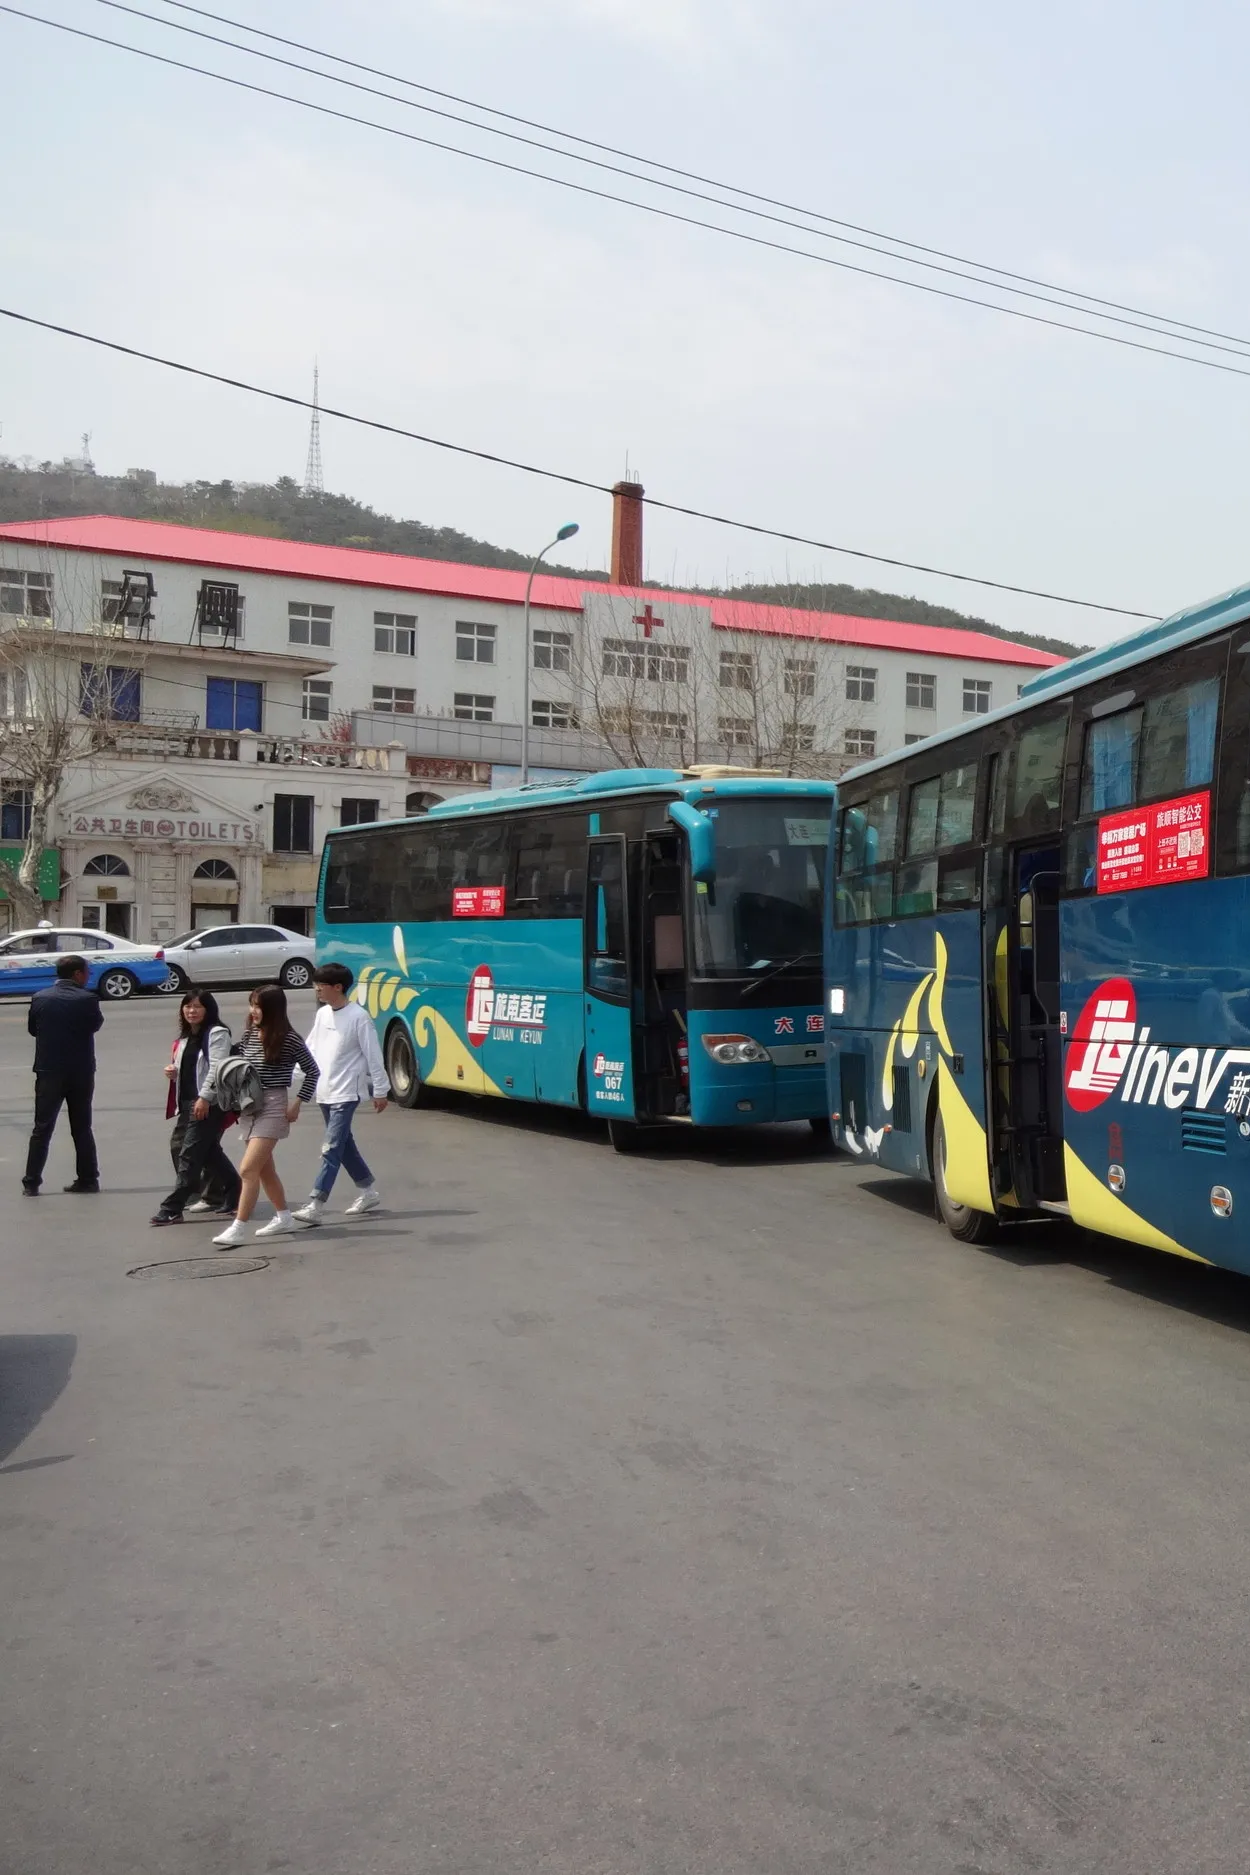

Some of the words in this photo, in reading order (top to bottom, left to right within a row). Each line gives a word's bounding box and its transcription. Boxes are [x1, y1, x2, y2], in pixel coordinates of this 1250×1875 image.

[1156, 803, 1202, 829] 旅顺智能公交
[73, 816, 154, 835] 公共卫生间
[177, 820, 253, 840] TOILETS
[493, 1027, 515, 1042] LUNAN
[520, 1029, 543, 1045] KEYUN
[605, 1076, 622, 1089] 067
